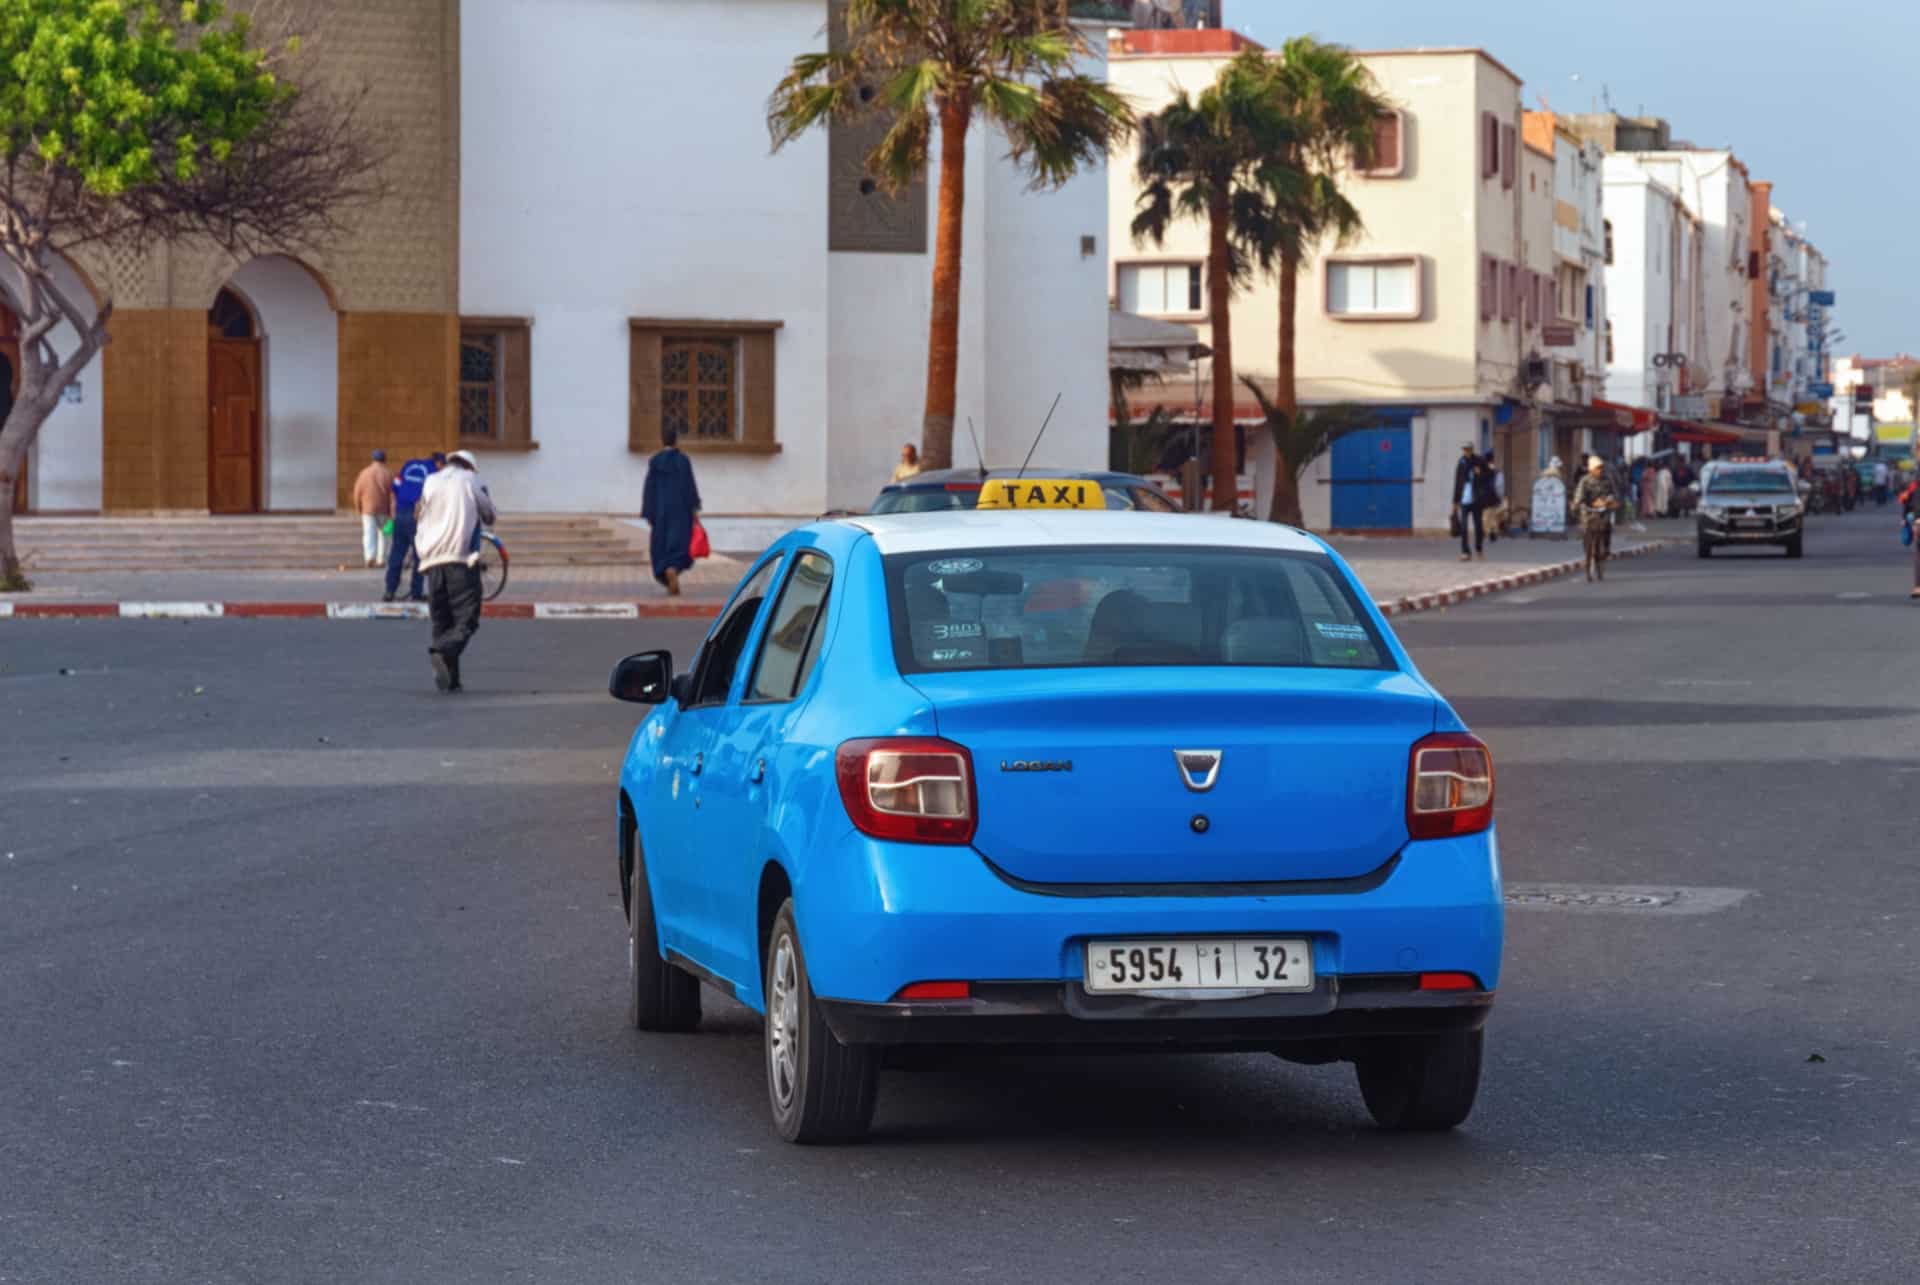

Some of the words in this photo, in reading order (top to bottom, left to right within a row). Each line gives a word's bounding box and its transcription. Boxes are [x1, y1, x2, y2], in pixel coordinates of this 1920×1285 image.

[1002, 485, 1085, 504] TAXI
[1000, 759, 1073, 773] LOGAN
[1109, 947, 1183, 983] 5954
[1253, 945, 1289, 981] 32
